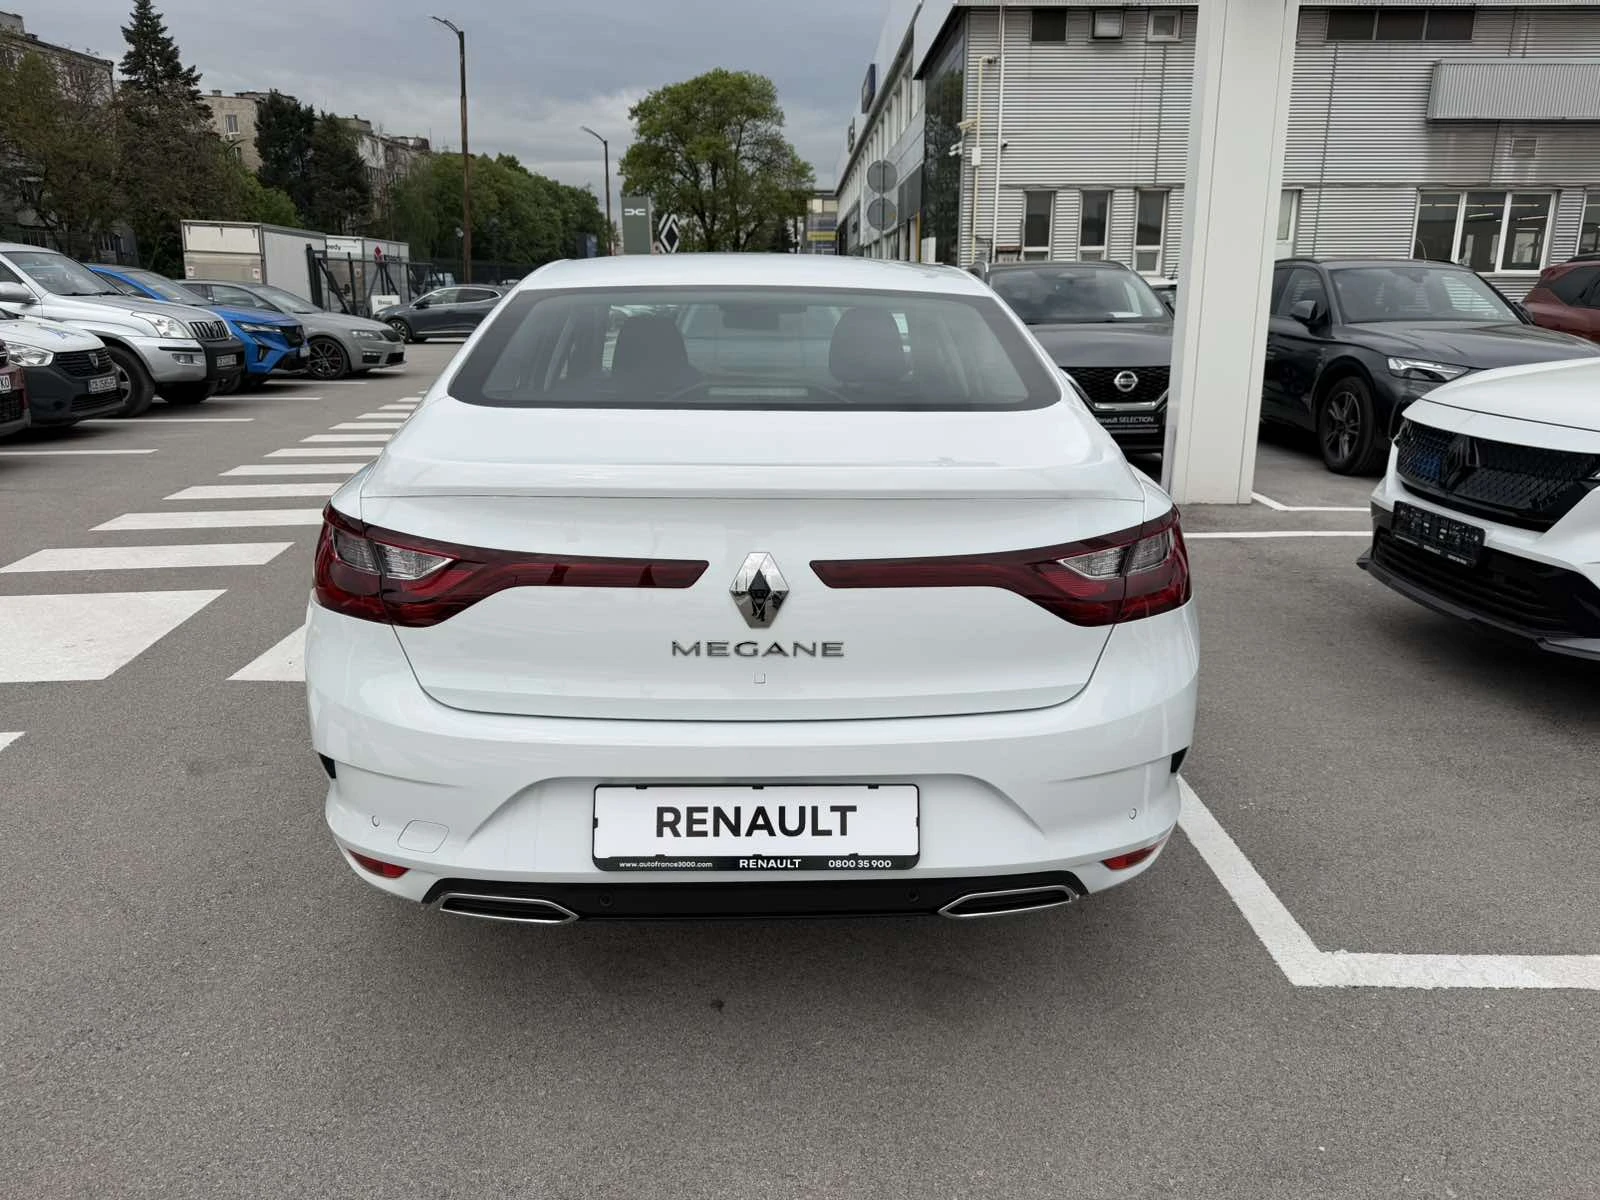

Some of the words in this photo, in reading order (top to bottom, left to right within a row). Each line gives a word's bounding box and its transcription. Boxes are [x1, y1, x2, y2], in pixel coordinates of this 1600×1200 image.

[1118, 415, 1154, 423] SELECTION
[671, 640, 845, 658] MEGANE
[656, 805, 857, 838] RENAULT
[619, 860, 713, 868] www.autofrance3000.com
[739, 858, 802, 869] RENAULT
[828, 859, 856, 868] 0800
[857, 859, 870, 868] 35
[871, 859, 892, 868] 900
